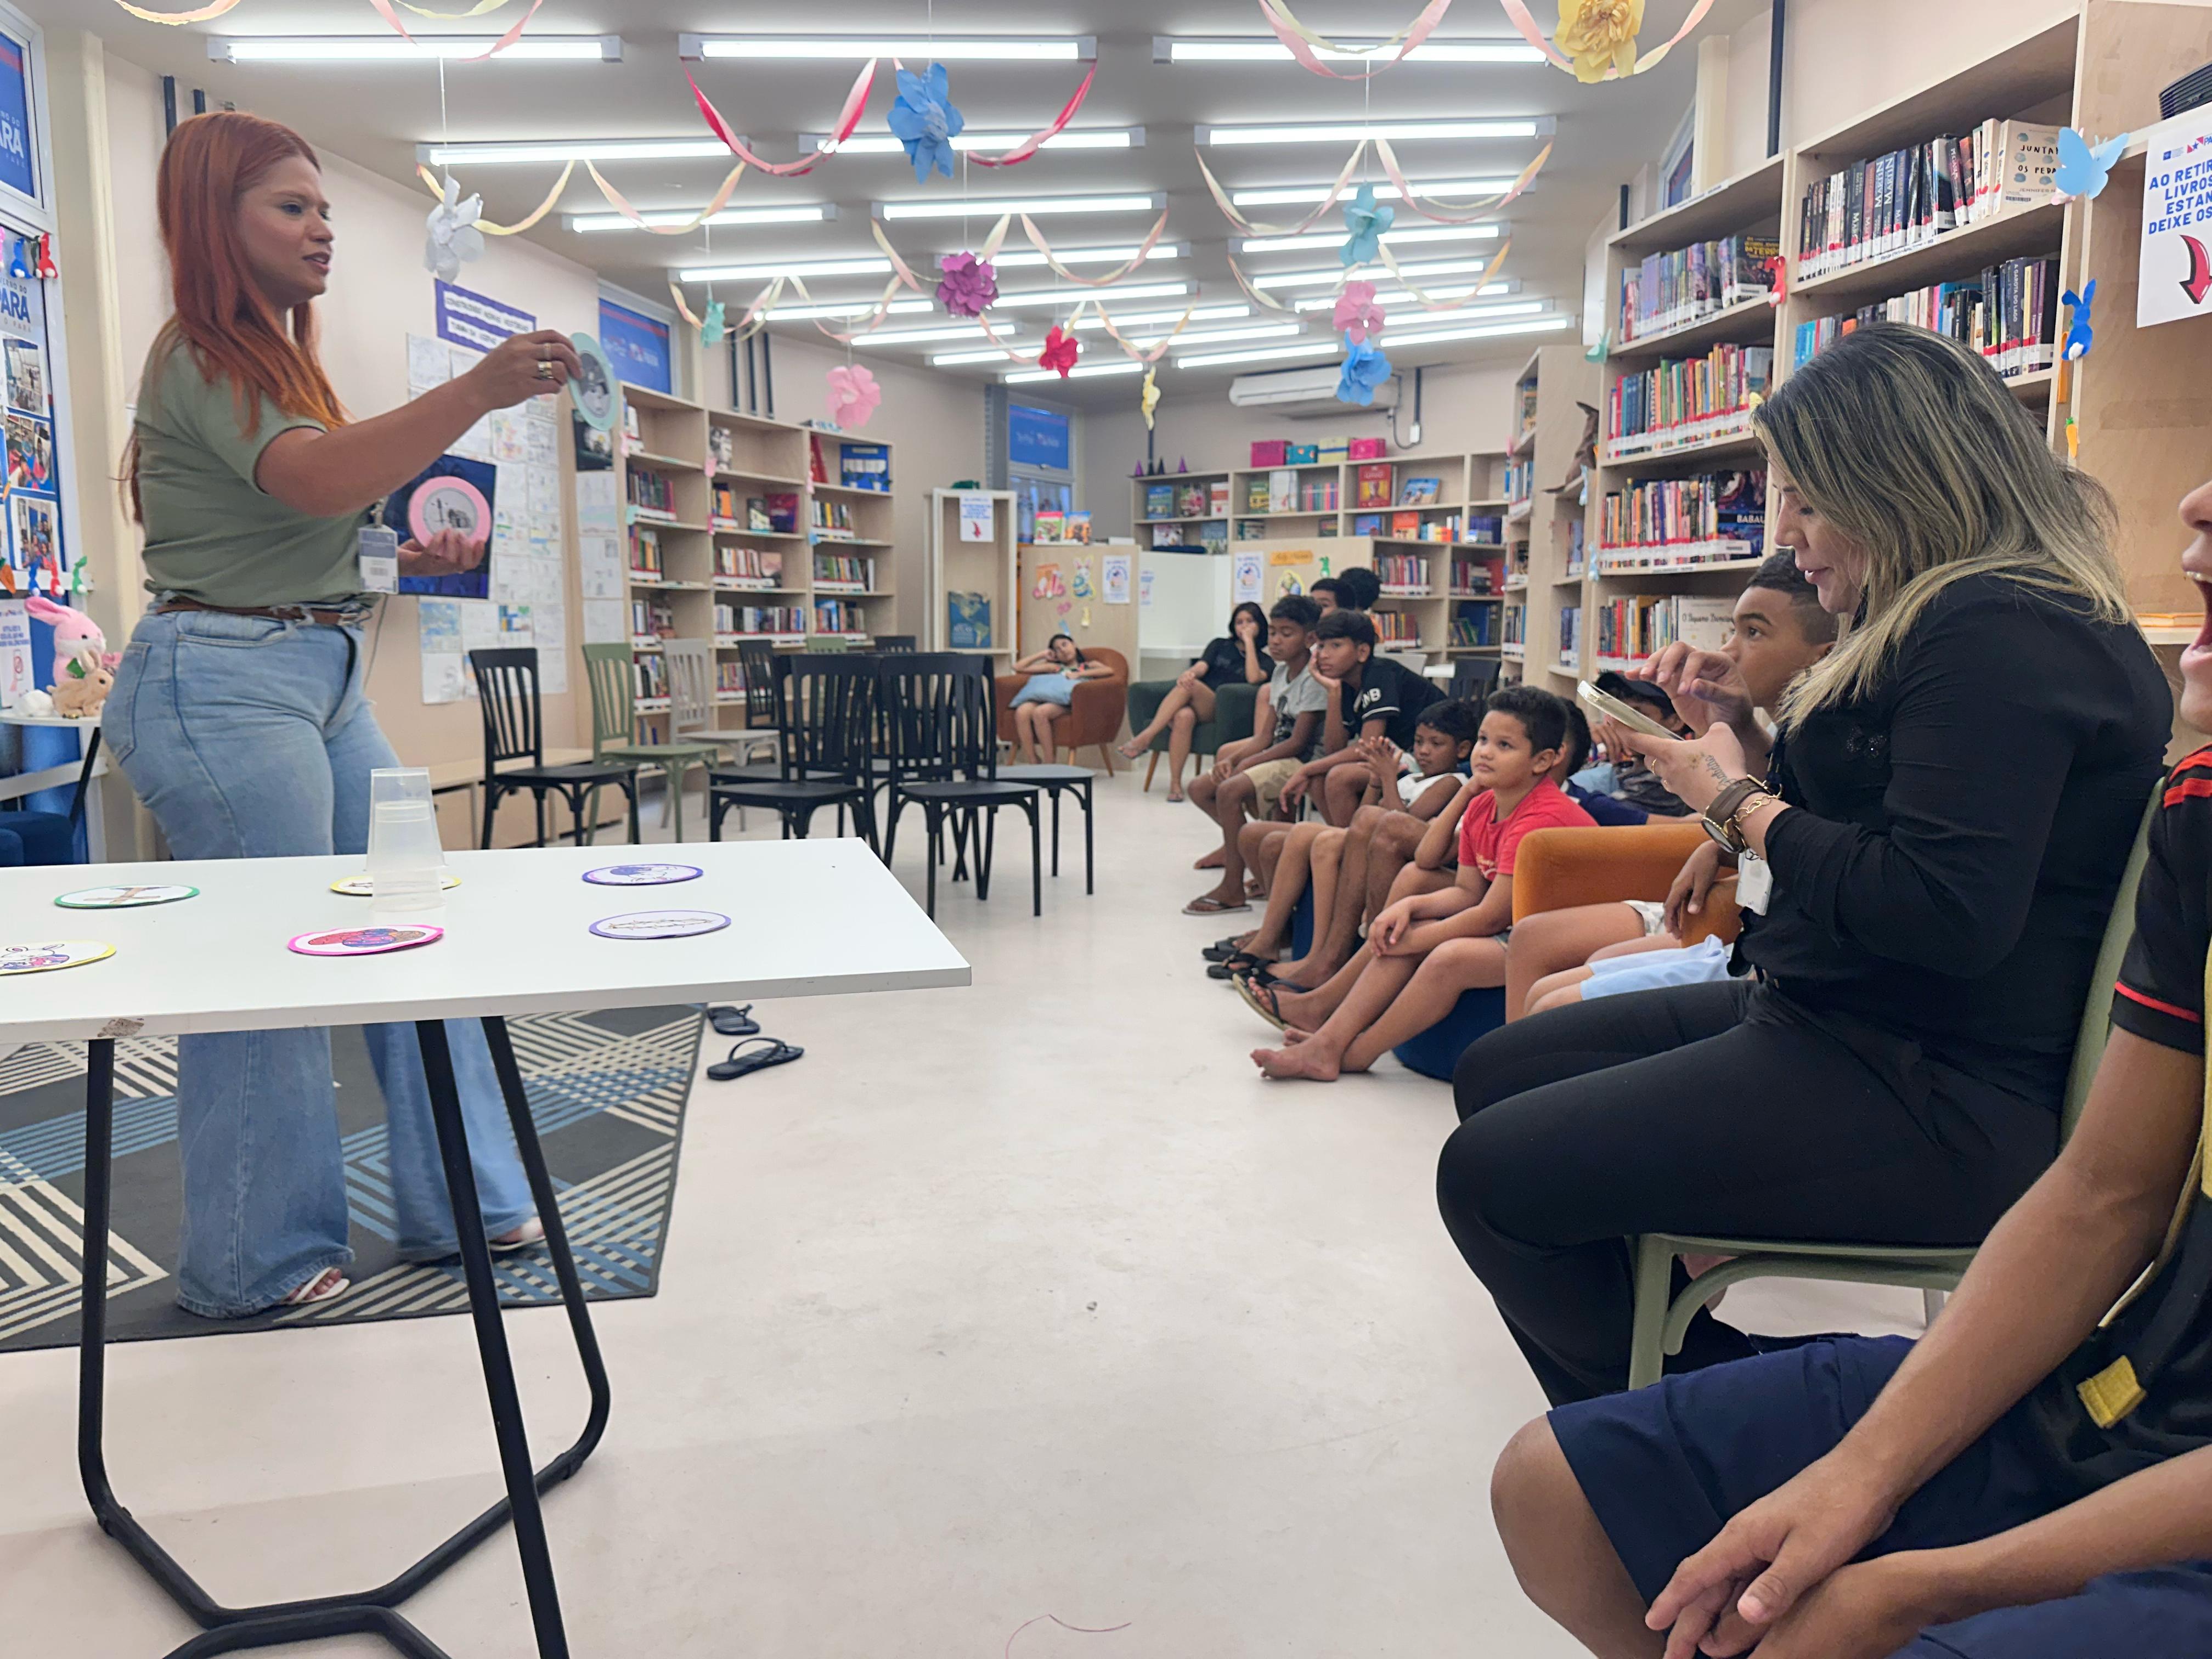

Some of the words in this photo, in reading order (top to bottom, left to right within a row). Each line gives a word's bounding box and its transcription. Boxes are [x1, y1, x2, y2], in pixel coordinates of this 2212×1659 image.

[2018, 165, 2028, 173] OS
[1875, 161, 1883, 208] MARTIN
[1884, 157, 1893, 205] MARTIN
[2149, 173, 2170, 190] AO
[2148, 212, 2192, 235] DEIXE
[2196, 206, 2212, 222] OS
[2013, 295, 2018, 304] DO
